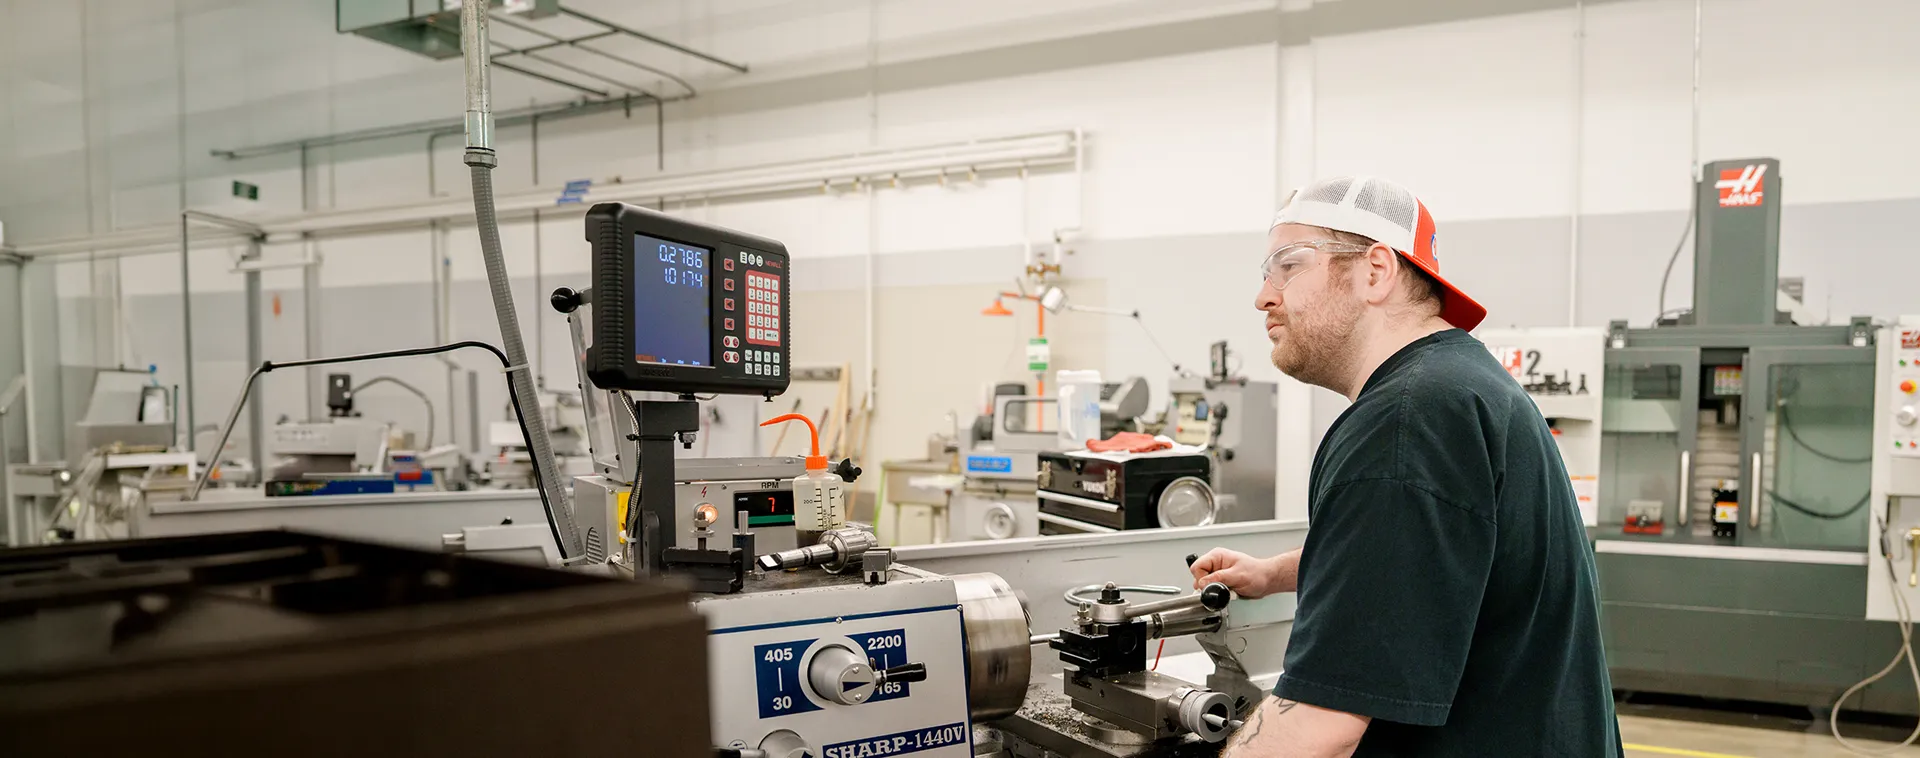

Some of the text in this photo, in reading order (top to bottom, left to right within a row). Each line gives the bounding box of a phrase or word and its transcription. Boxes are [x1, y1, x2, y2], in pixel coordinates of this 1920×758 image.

[659, 244, 703, 269] 0.2786
[1525, 350, 1541, 376] 2
[761, 481, 779, 489] RPM
[767, 497, 775, 513] 7
[867, 634, 902, 651] 2200
[764, 647, 793, 663] 405
[772, 696, 792, 711] 30
[825, 725, 964, 758] SHARP-1440V
